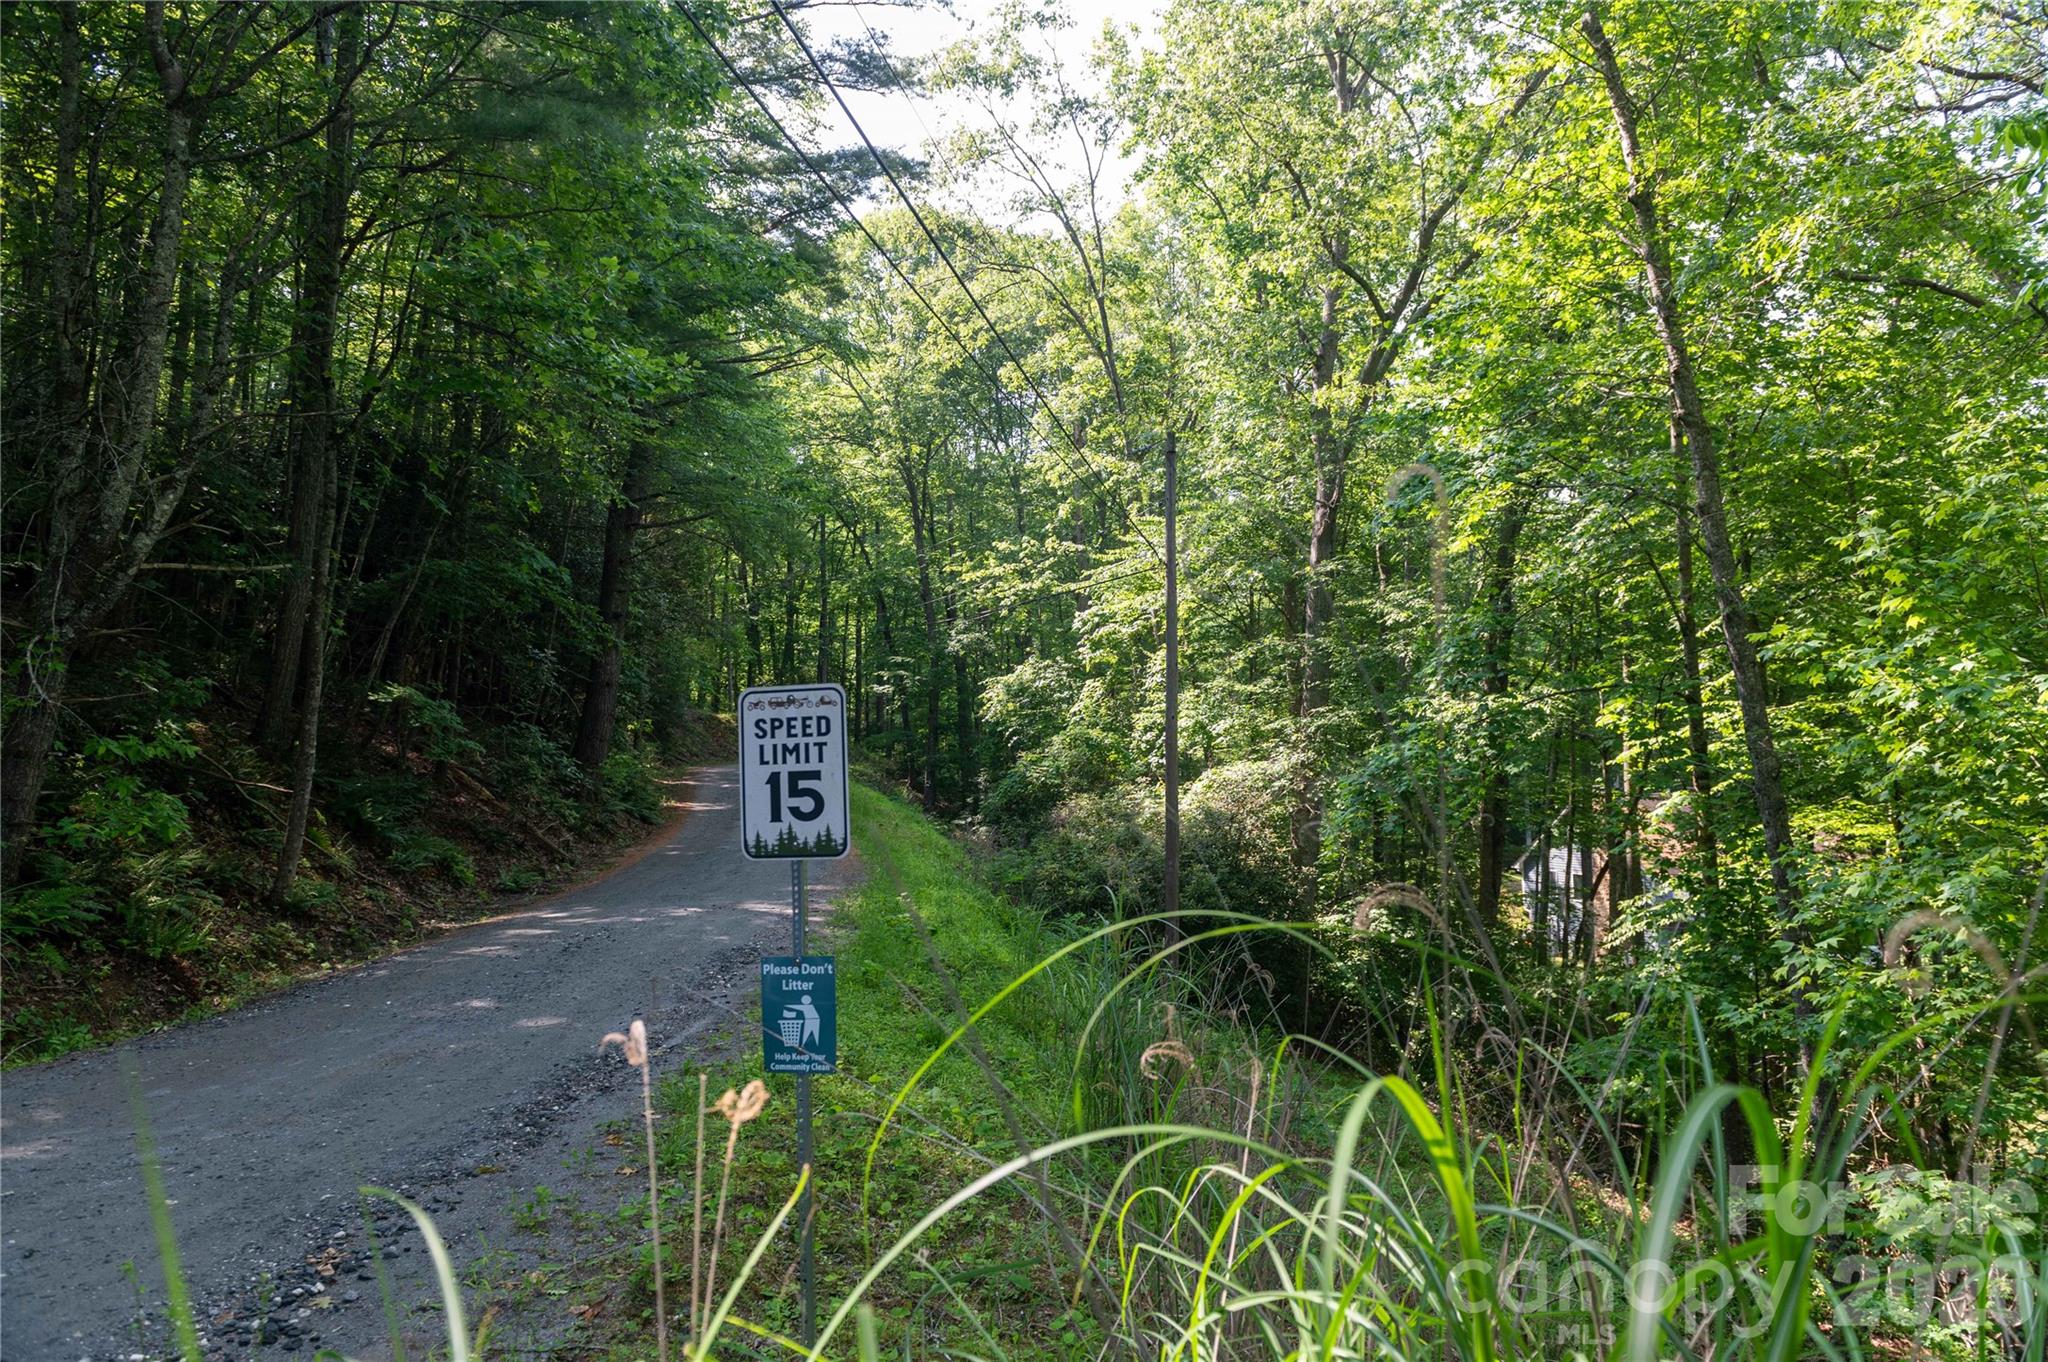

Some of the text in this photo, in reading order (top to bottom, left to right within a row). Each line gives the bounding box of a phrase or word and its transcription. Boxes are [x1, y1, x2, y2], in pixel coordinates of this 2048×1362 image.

[754, 716, 831, 739] SPEED
[758, 742, 828, 765] LIMIT
[765, 770, 825, 823] 15
[763, 963, 833, 975] Please Don't
[782, 979, 814, 991] Litter
[774, 1052, 826, 1062] Help Keep Your
[770, 1063, 830, 1073] Community Clean
